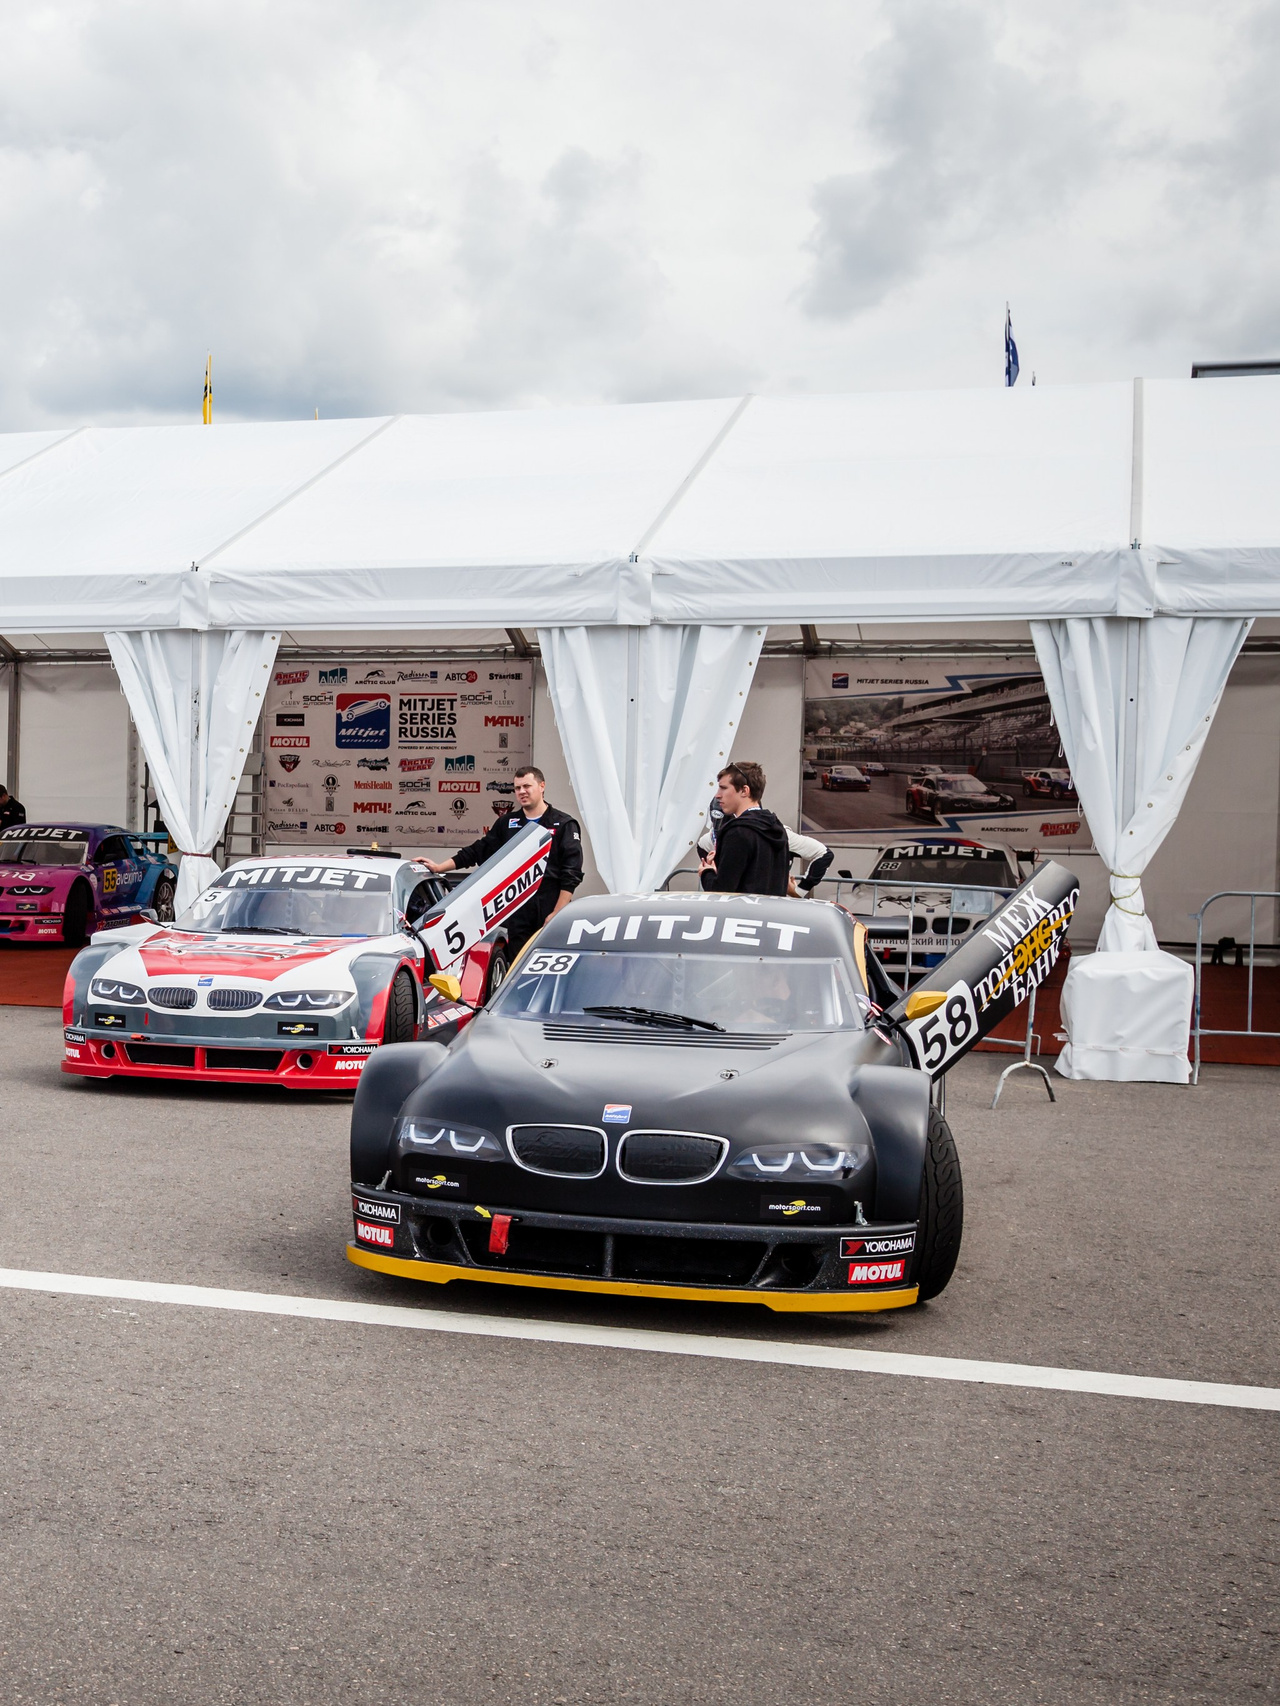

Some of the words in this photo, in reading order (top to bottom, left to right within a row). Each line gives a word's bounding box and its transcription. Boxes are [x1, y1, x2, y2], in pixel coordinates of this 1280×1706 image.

[399, 698, 457, 711] MITJET
[398, 712, 457, 725] SERIES
[398, 727, 456, 738] RUSSIA
[272, 738, 308, 746] MOTUL
[399, 758, 434, 767] ARCTIC
[440, 783, 479, 791] MOTUL
[2, 828, 82, 840] MITJET
[893, 845, 995, 859] MITJET
[880, 862, 900, 870] 88
[104, 872, 117, 890] 55
[228, 867, 379, 889] MITJET
[204, 891, 221, 902] 5
[982, 885, 1054, 956] МЕЖ
[444, 920, 466, 955] 5
[567, 915, 811, 951] MITJET
[528, 955, 573, 973] 58
[1011, 935, 1063, 1008] БАНК
[919, 995, 972, 1069] 58
[335, 1060, 366, 1070] MOTU
[415, 1176, 460, 1188] motorsport.com
[357, 1202, 397, 1219] YOKOHAMA
[768, 1203, 821, 1212] motorsport.com
[357, 1222, 392, 1245] MOTUL
[864, 1237, 912, 1253] YOKOHAMA
[851, 1263, 902, 1281] MOTUL
